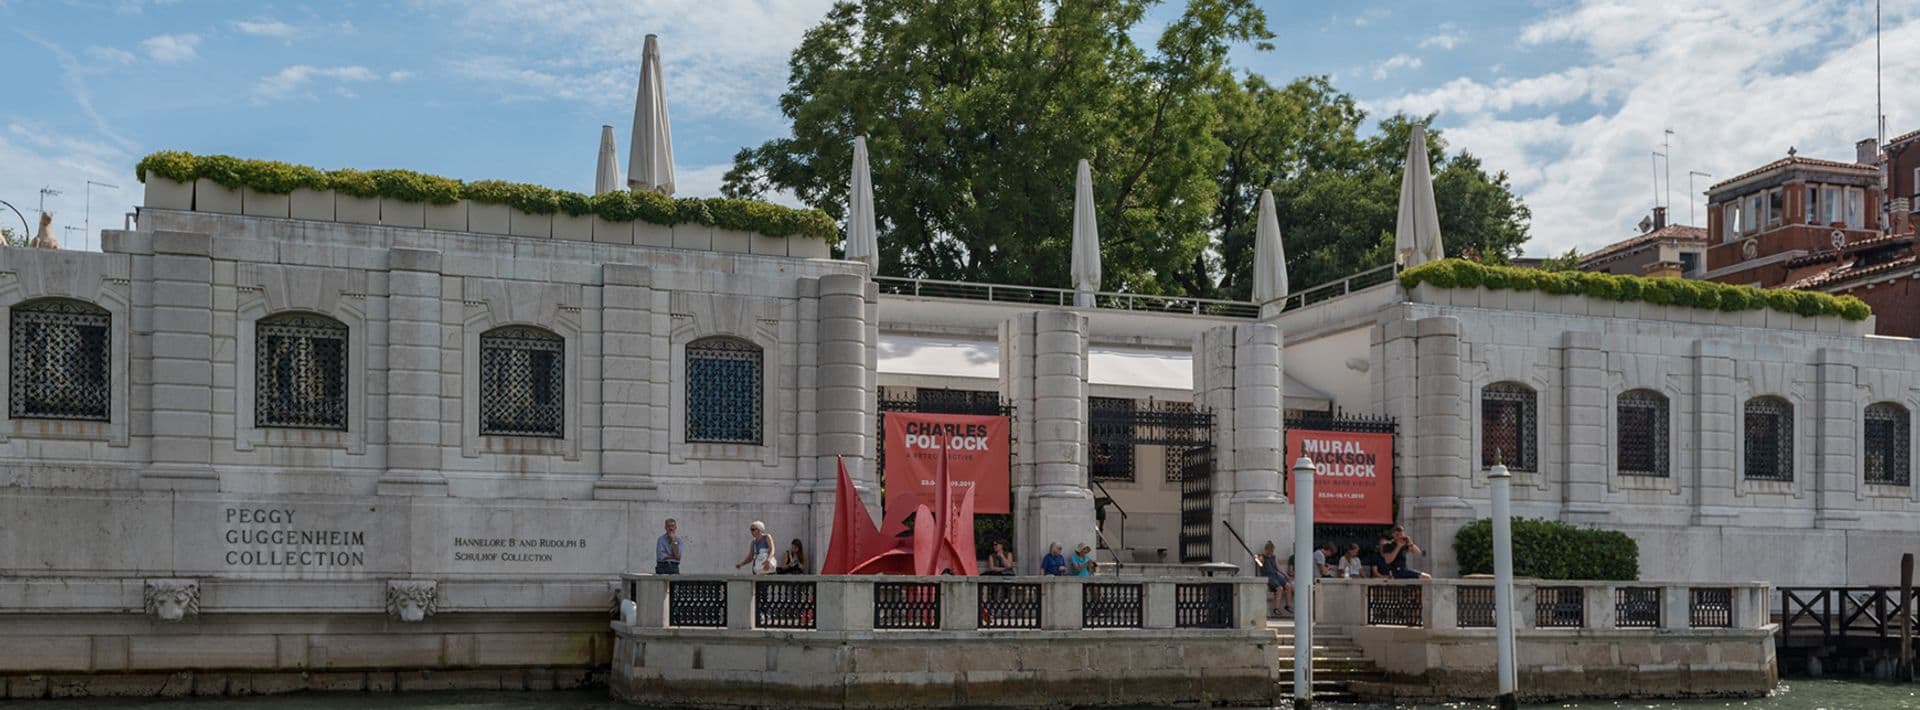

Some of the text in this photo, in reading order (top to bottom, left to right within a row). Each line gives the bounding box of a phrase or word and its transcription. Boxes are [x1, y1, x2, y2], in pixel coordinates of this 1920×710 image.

[906, 422, 988, 437] CHARLES
[1304, 439, 1365, 454] MURAL
[1315, 463, 1376, 477] OLLOCK
[226, 508, 296, 524] PEGGY
[225, 529, 365, 546] GUGGENHEIM
[454, 537, 587, 549] HANNELORE B AND RUDOLPH B
[225, 550, 365, 567] COLLECTION
[500, 552, 553, 562] COLLECTION
